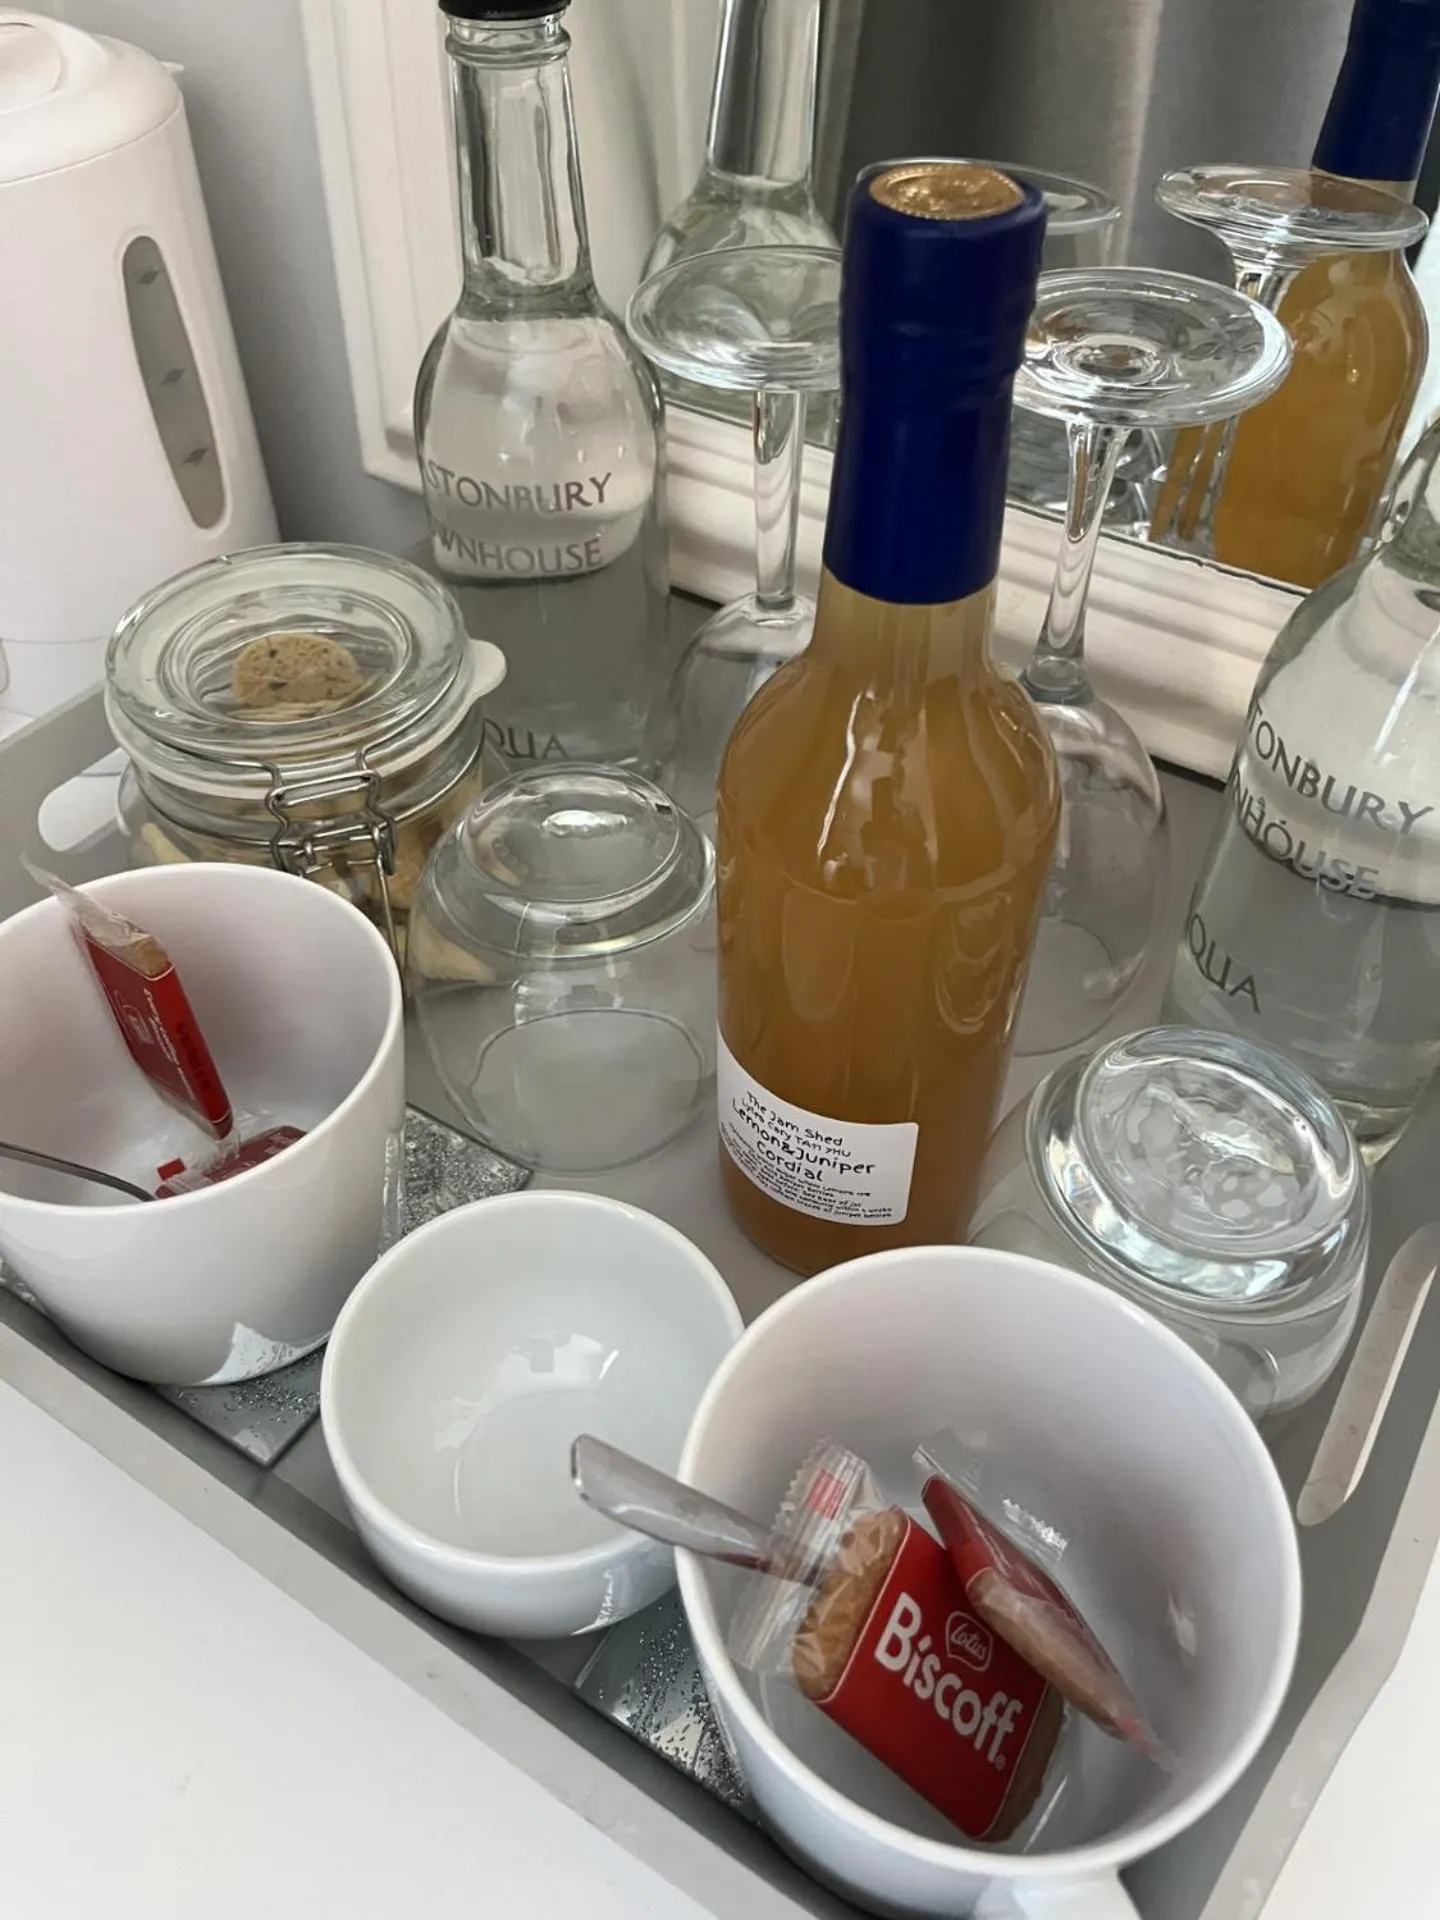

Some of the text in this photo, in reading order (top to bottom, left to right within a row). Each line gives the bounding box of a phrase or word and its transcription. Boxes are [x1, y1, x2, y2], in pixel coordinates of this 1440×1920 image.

[747, 1090, 843, 1146] The Jam Shed
[757, 1140, 823, 1181] Cordial
[951, 1622, 987, 1662] Lotus
[874, 1591, 1023, 1763] Biscoff
